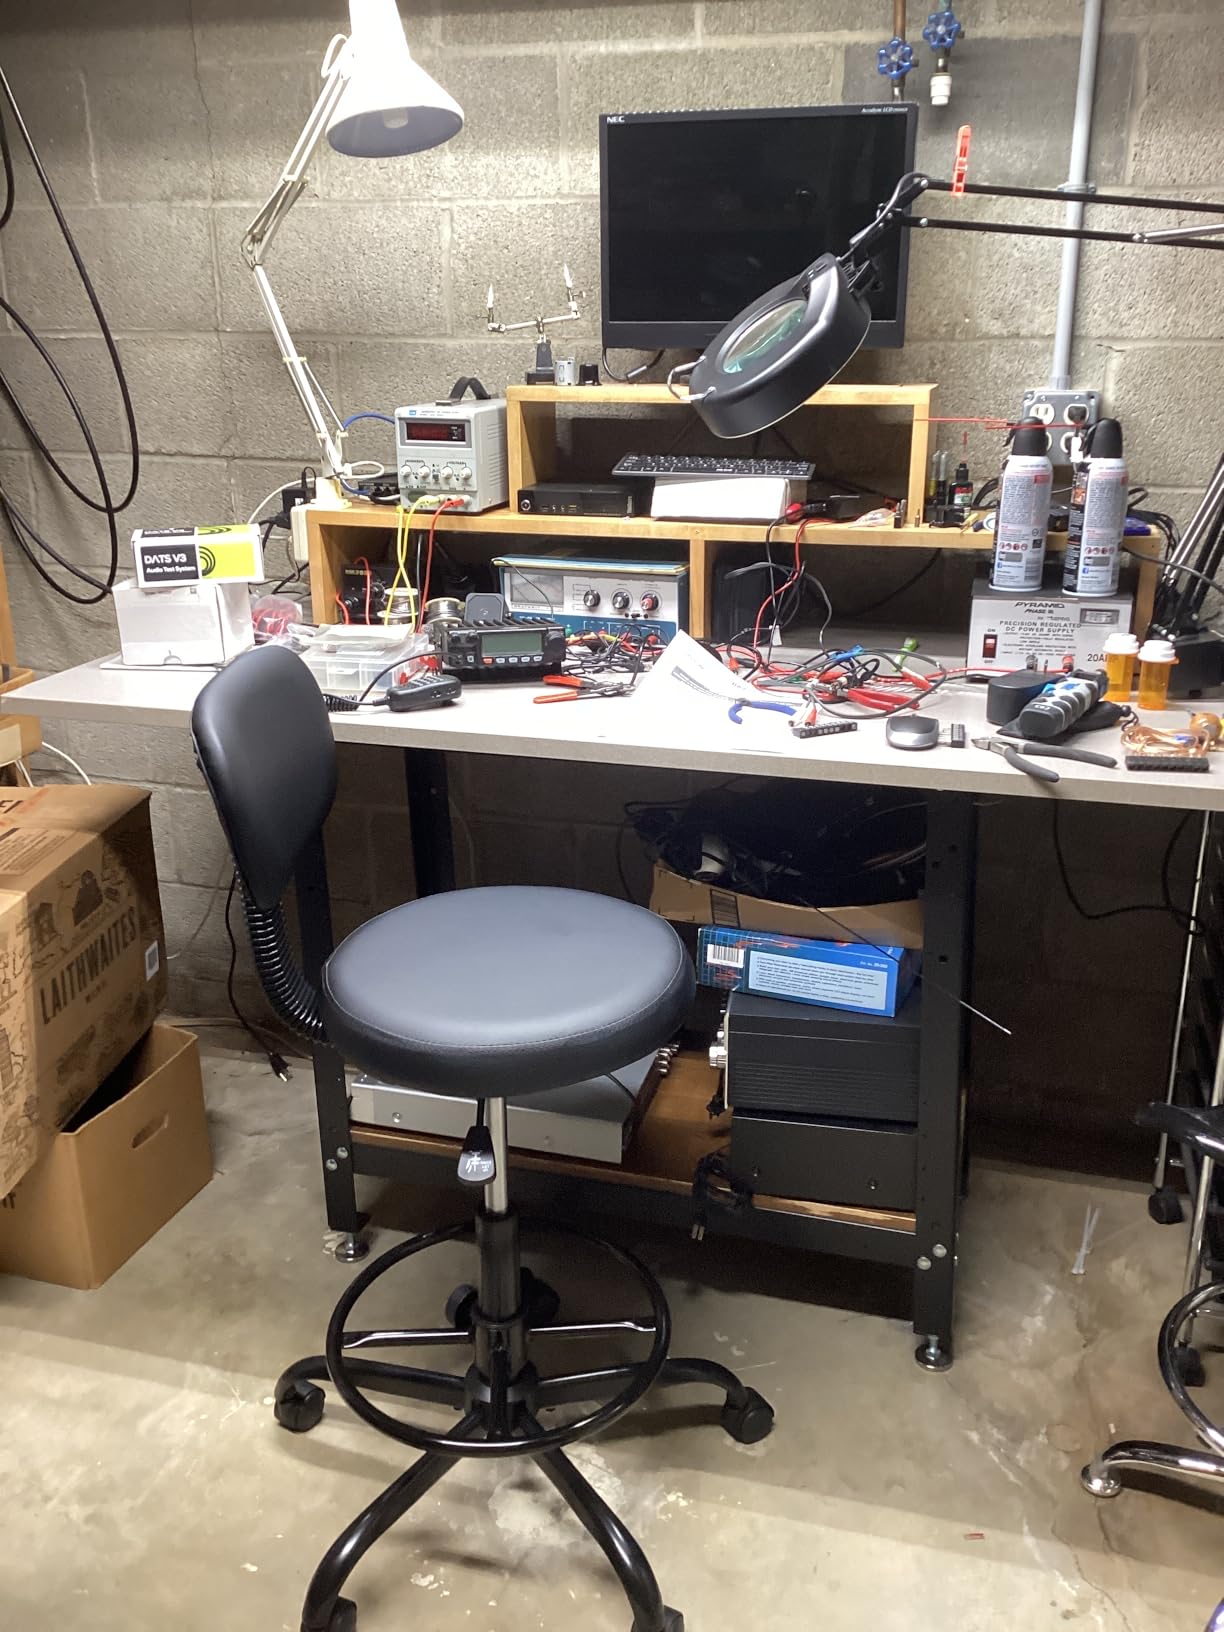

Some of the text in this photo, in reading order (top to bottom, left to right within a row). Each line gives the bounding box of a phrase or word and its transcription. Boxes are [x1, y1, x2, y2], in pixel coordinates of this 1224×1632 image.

[606, 115, 625, 124] NEC
[144, 553, 187, 564] DATS V3
[1040, 621, 1083, 629] REGULATED
[39, 905, 137, 1025] LAITHWAITES
